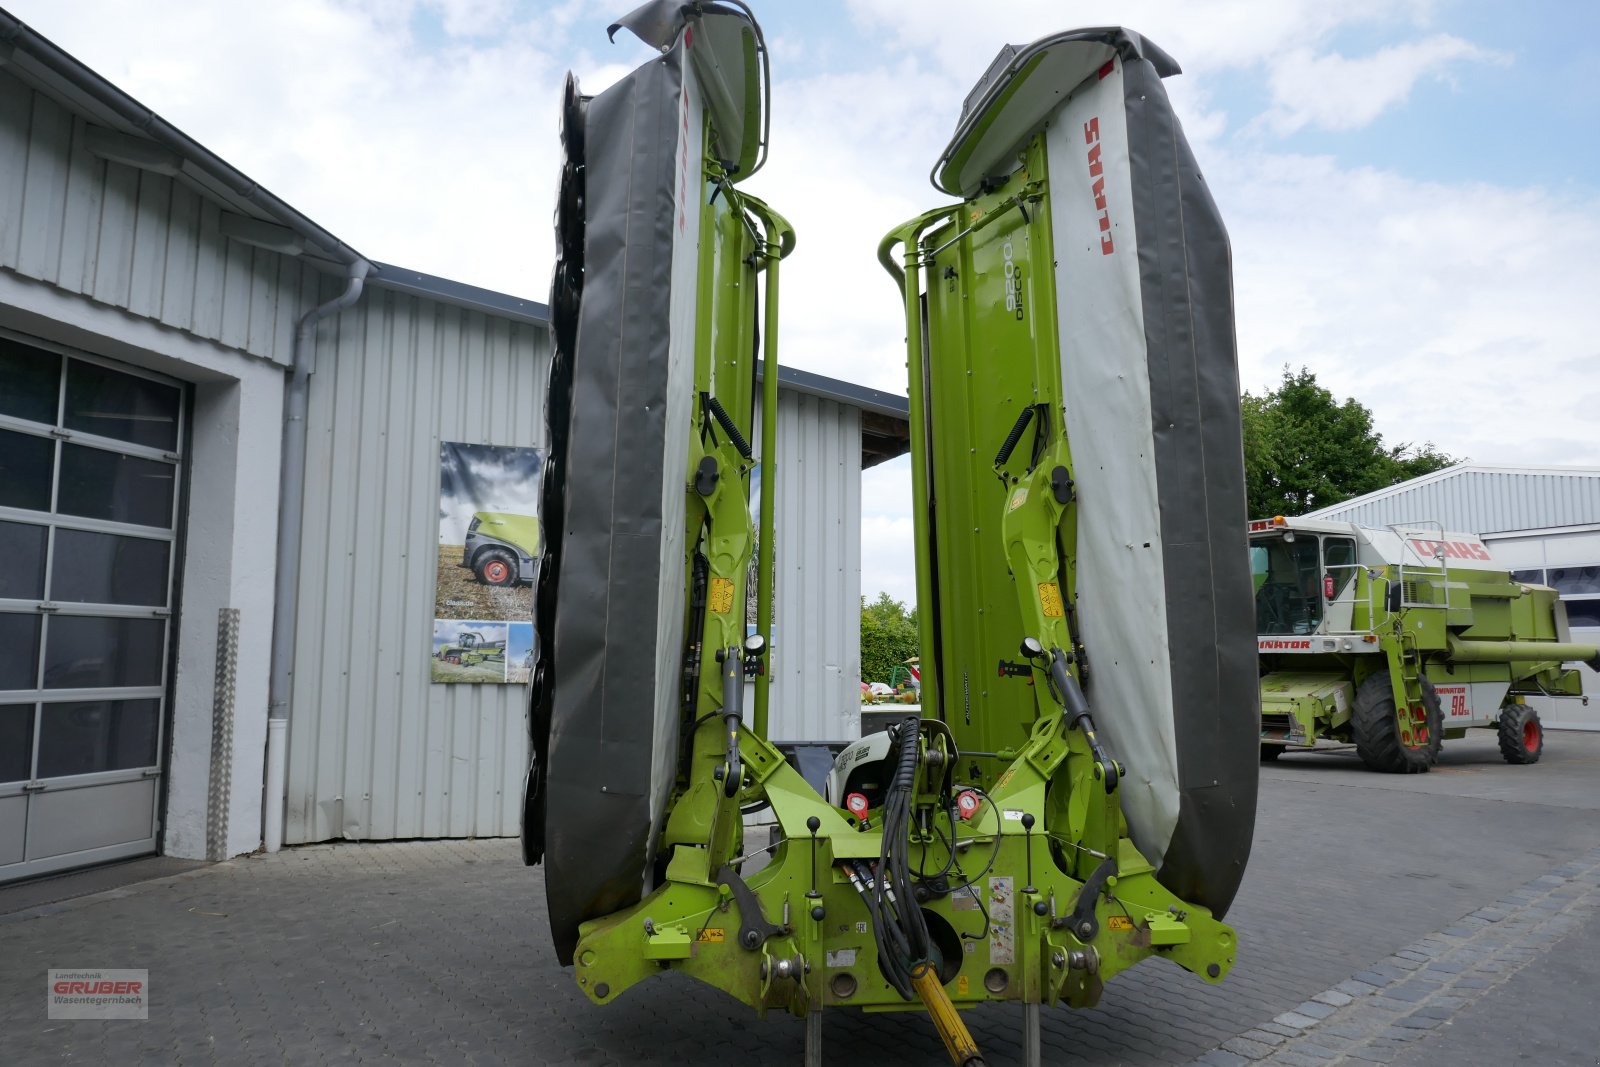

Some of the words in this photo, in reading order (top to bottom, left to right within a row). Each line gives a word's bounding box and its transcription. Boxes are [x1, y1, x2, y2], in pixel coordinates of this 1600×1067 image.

[1084, 117, 1115, 255] CLAAS
[1003, 242, 1016, 312] 9200
[1014, 266, 1024, 321] DISCO
[1451, 695, 1465, 716] 98
